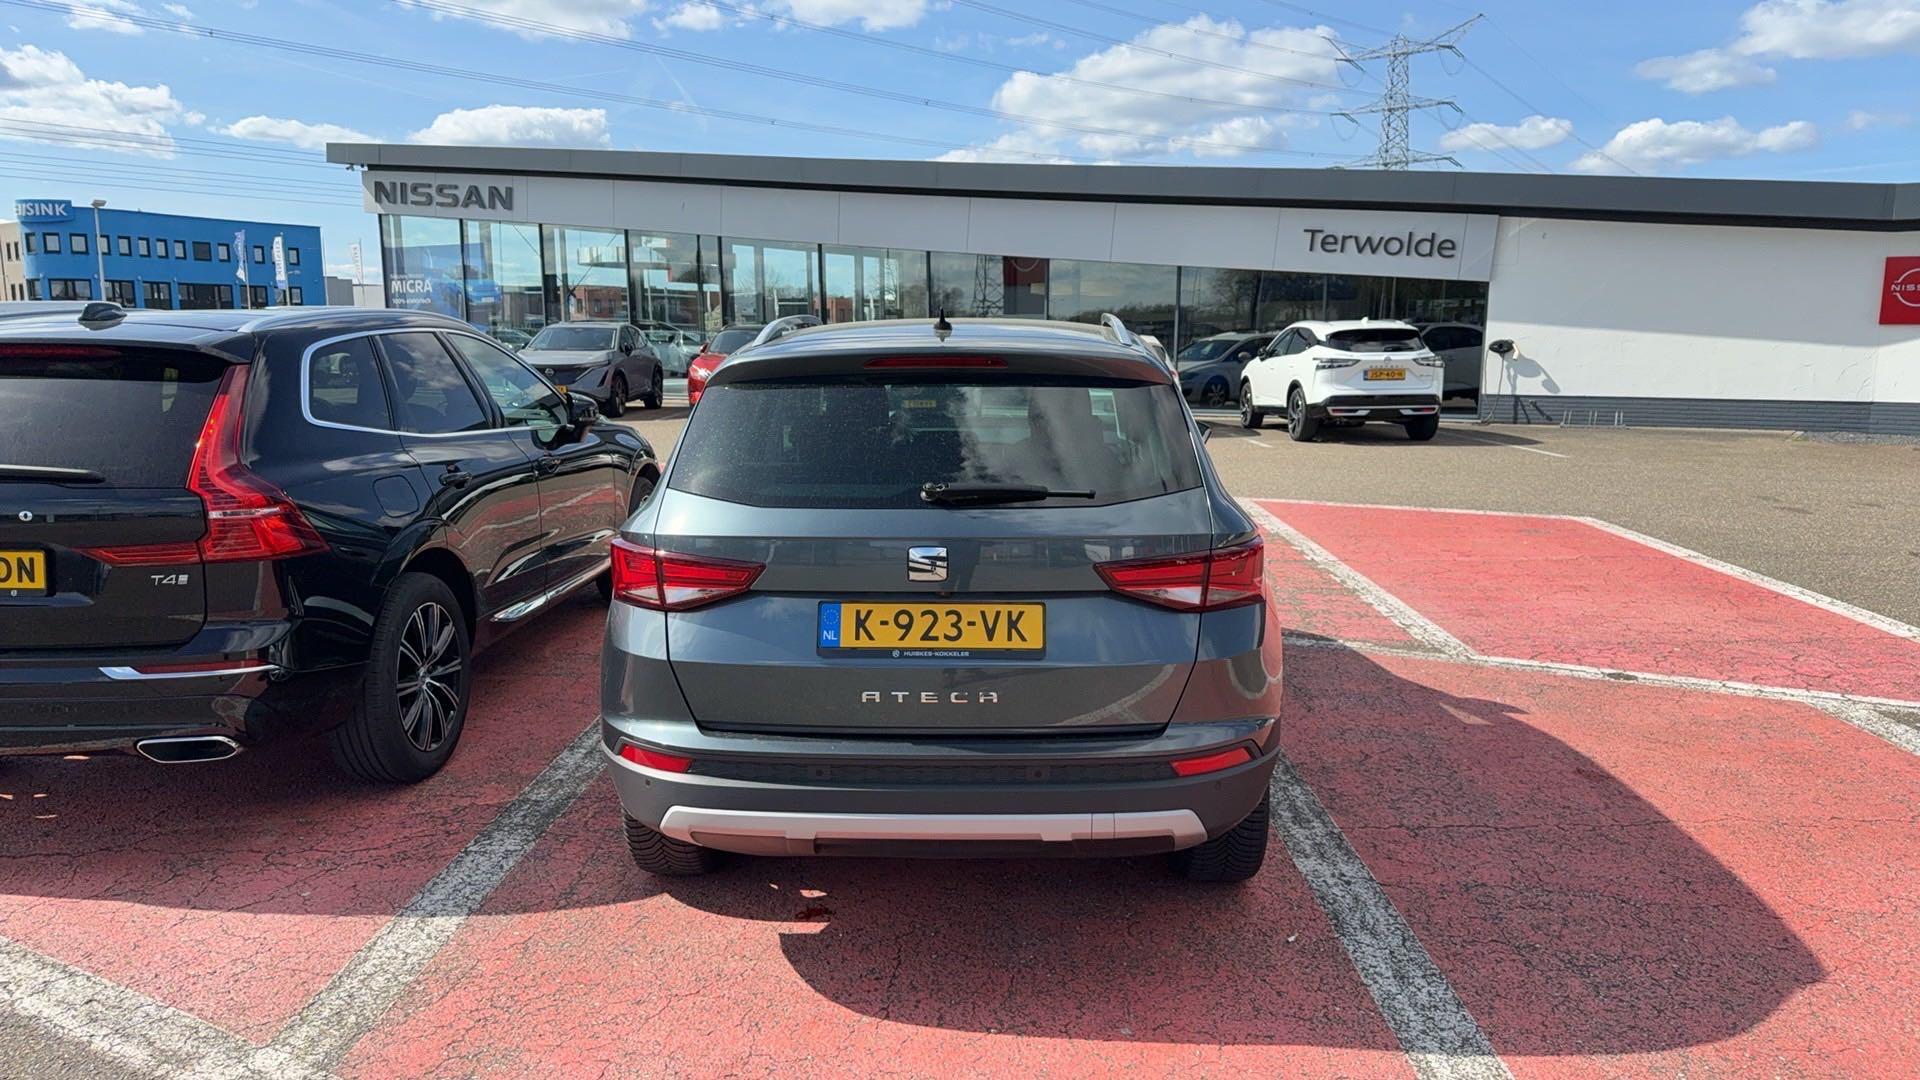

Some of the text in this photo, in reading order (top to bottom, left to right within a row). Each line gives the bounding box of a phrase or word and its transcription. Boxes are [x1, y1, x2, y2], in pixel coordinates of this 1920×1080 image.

[374, 181, 513, 210] NISSAN
[1304, 229, 1457, 258] Terwolde
[391, 279, 433, 293] MICRA
[823, 630, 838, 640] NL
[854, 609, 1028, 642] K-923-VK
[861, 691, 998, 703] ATECA
